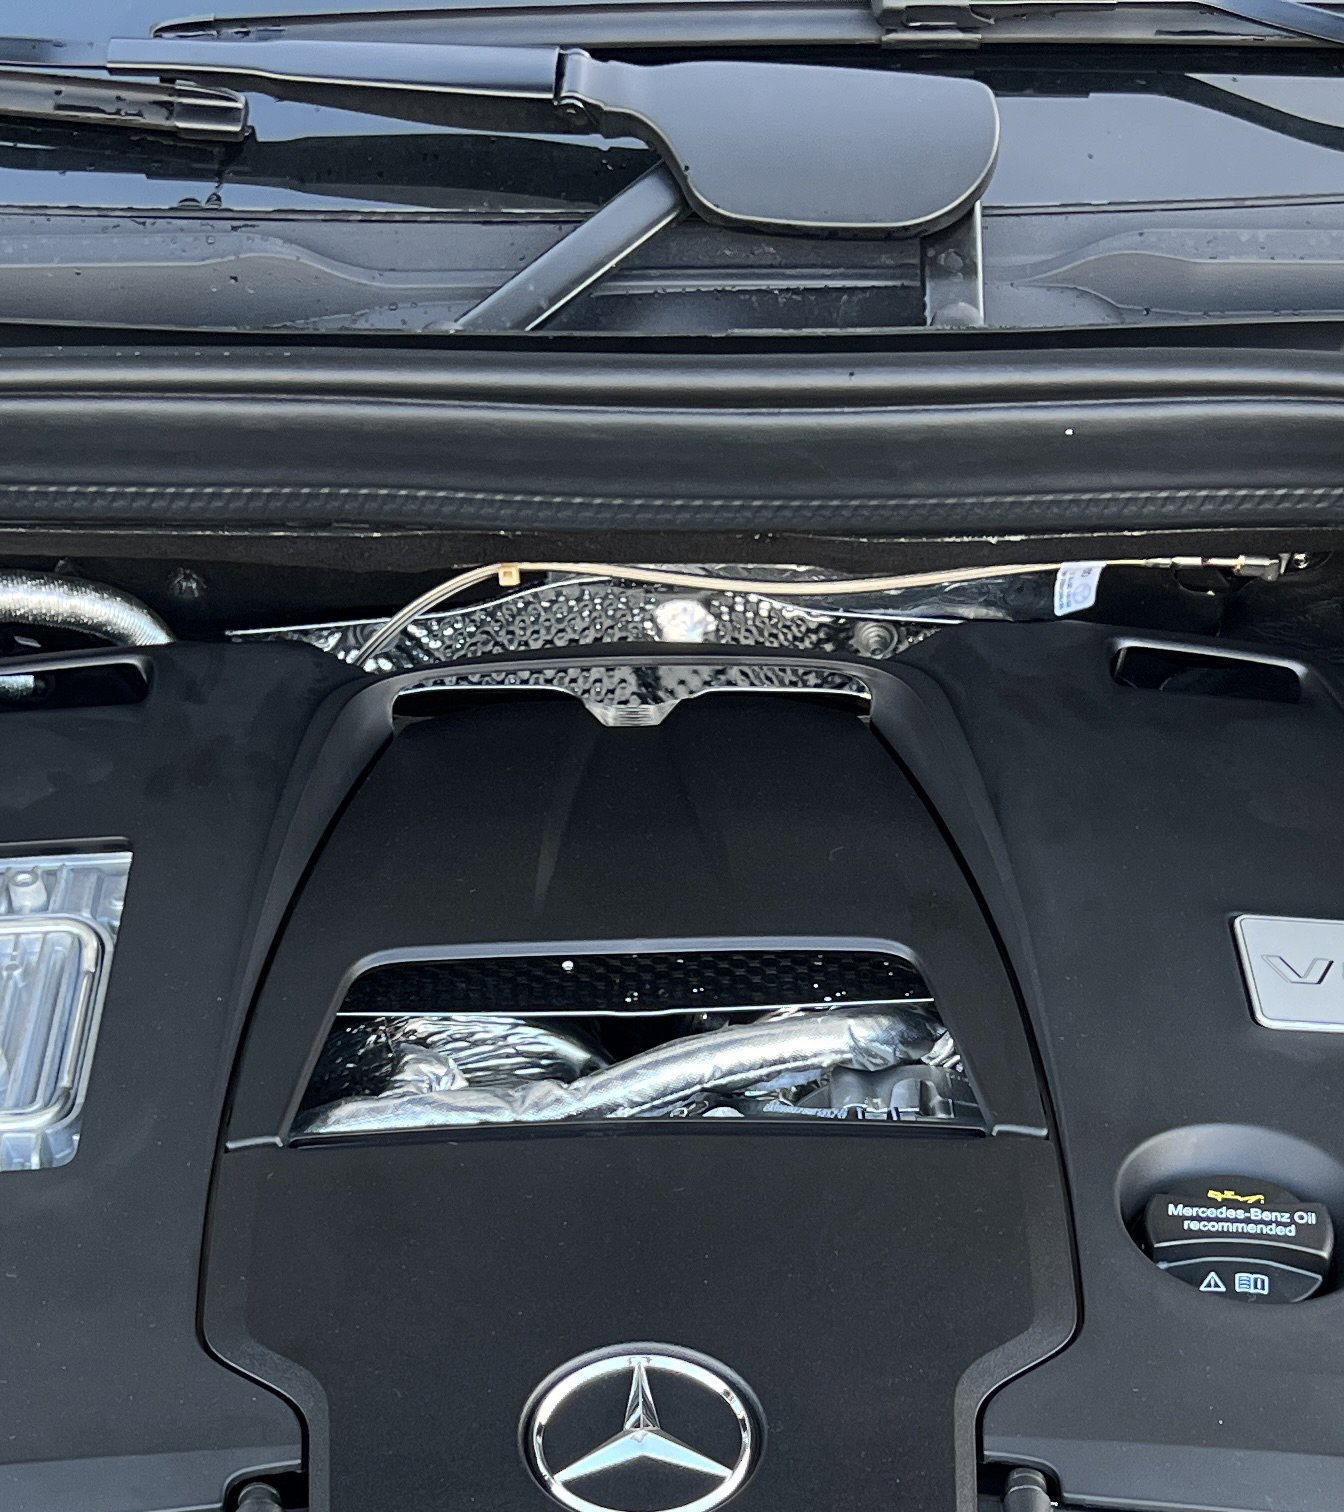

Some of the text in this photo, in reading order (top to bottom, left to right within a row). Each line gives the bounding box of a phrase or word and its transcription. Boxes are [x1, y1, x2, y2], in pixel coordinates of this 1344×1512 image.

[1167, 1203, 1317, 1225] Mercedes-Benz Oil
[1183, 1219, 1297, 1237] recommended
